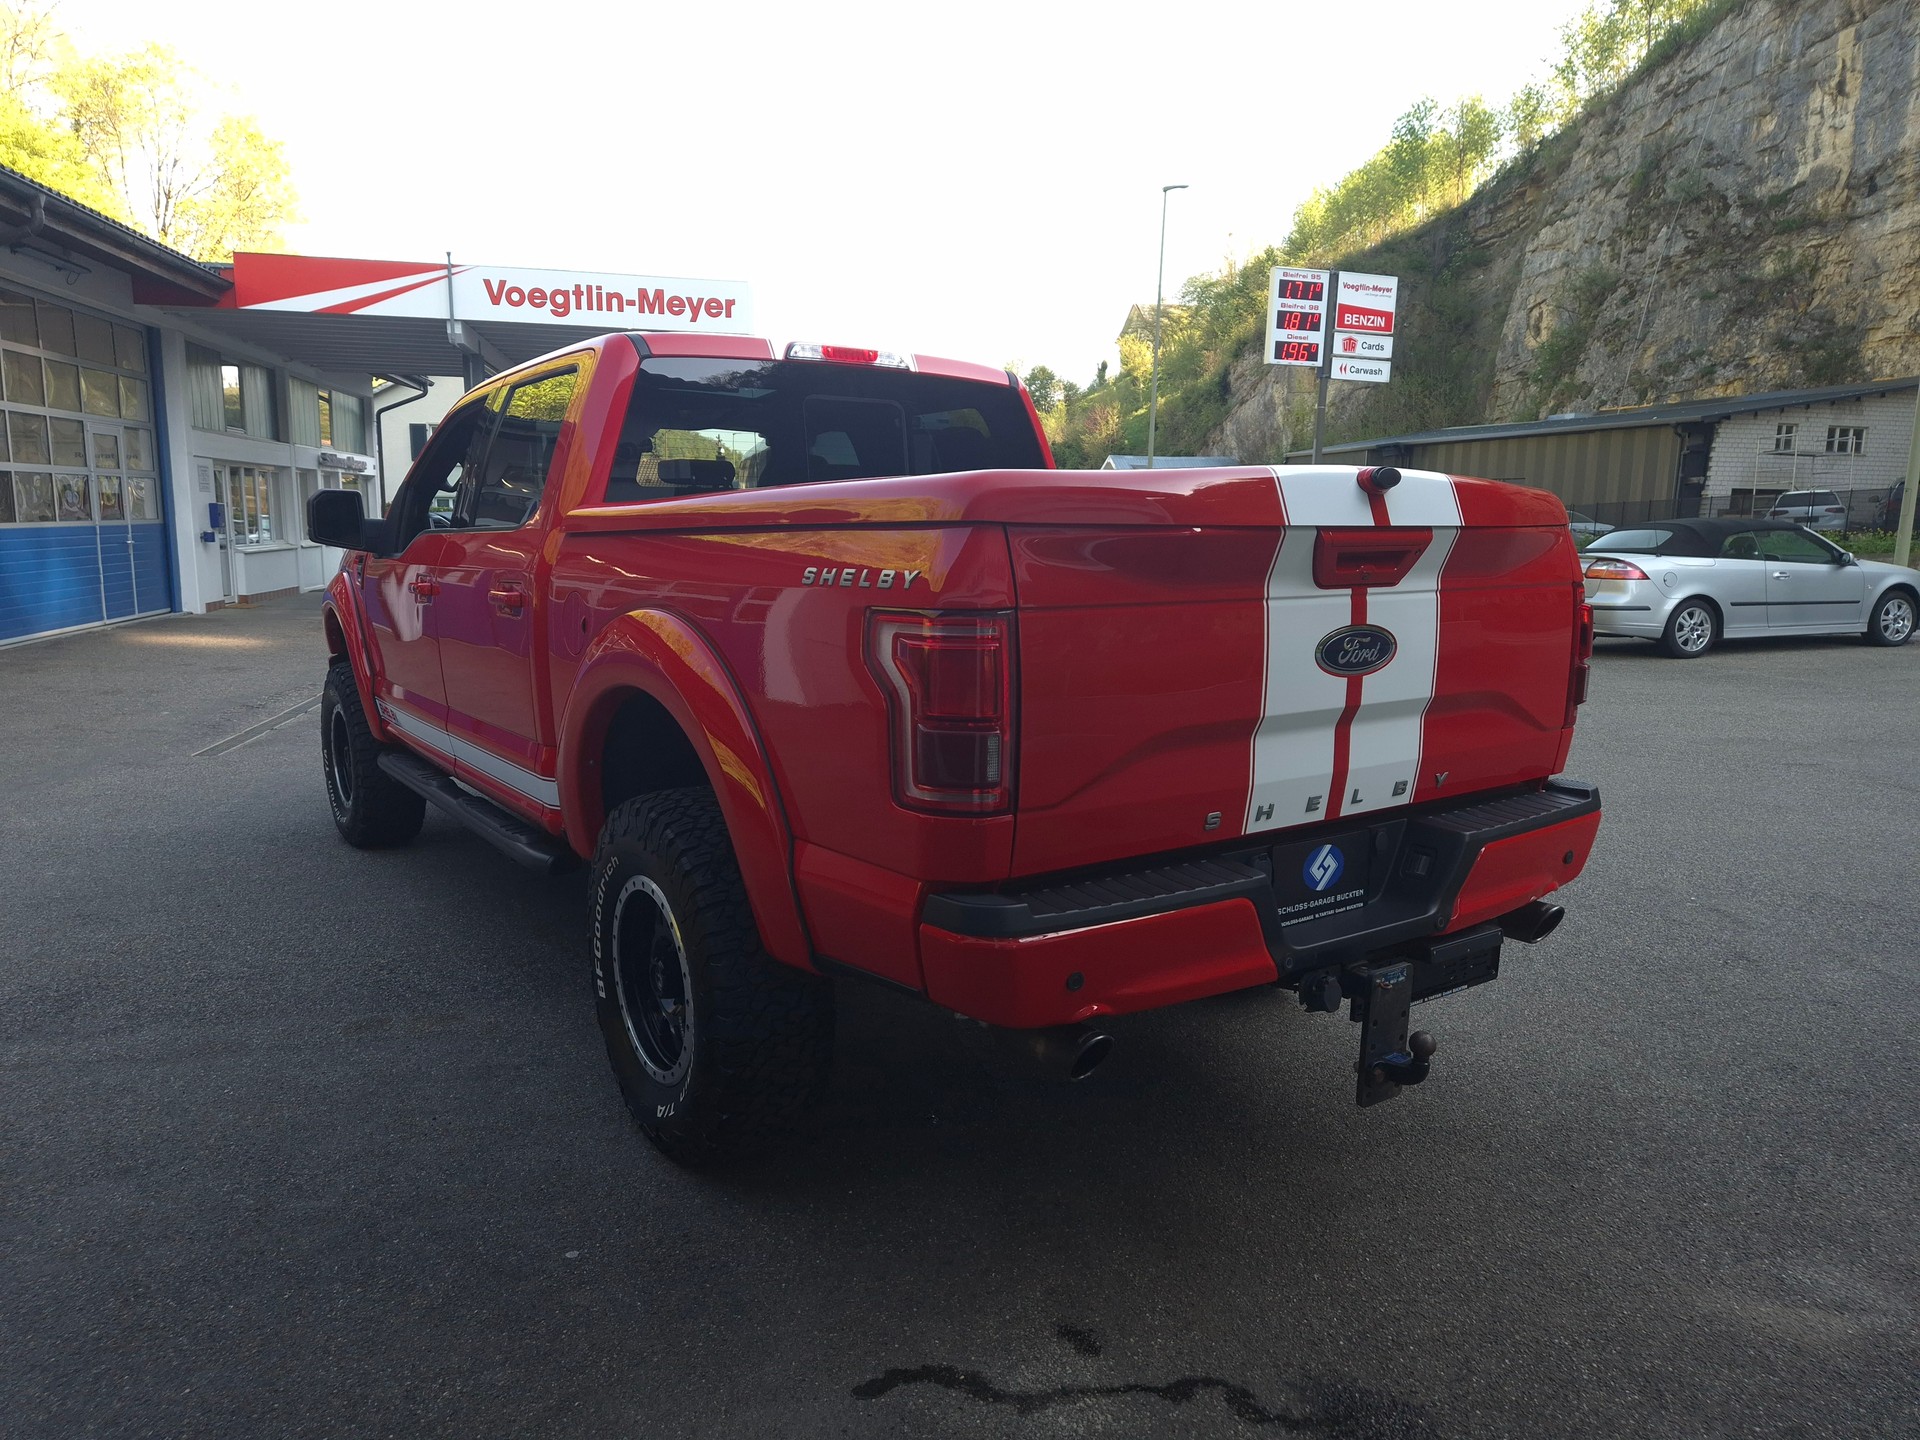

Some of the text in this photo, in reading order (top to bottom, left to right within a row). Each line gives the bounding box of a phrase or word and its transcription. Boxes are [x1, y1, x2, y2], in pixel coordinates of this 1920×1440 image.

[1282, 271, 1308, 279] Bleifrei
[1342, 281, 1393, 294] Voegtlin-Meyer
[482, 278, 736, 322] Voegtlin-Meyer
[1280, 302, 1306, 310] Bleifrei
[1344, 313, 1386, 328] BENZIN
[1361, 341, 1385, 351] Cards
[1349, 365, 1383, 376] Carwash
[801, 566, 921, 589] SHELBY
[1338, 636, 1381, 664] Ford
[1277, 888, 1364, 915] SCHLOSS-GARAGE BUCKTEN
[592, 855, 620, 999] BFGoodrich
[656, 1102, 675, 1119] T/A
